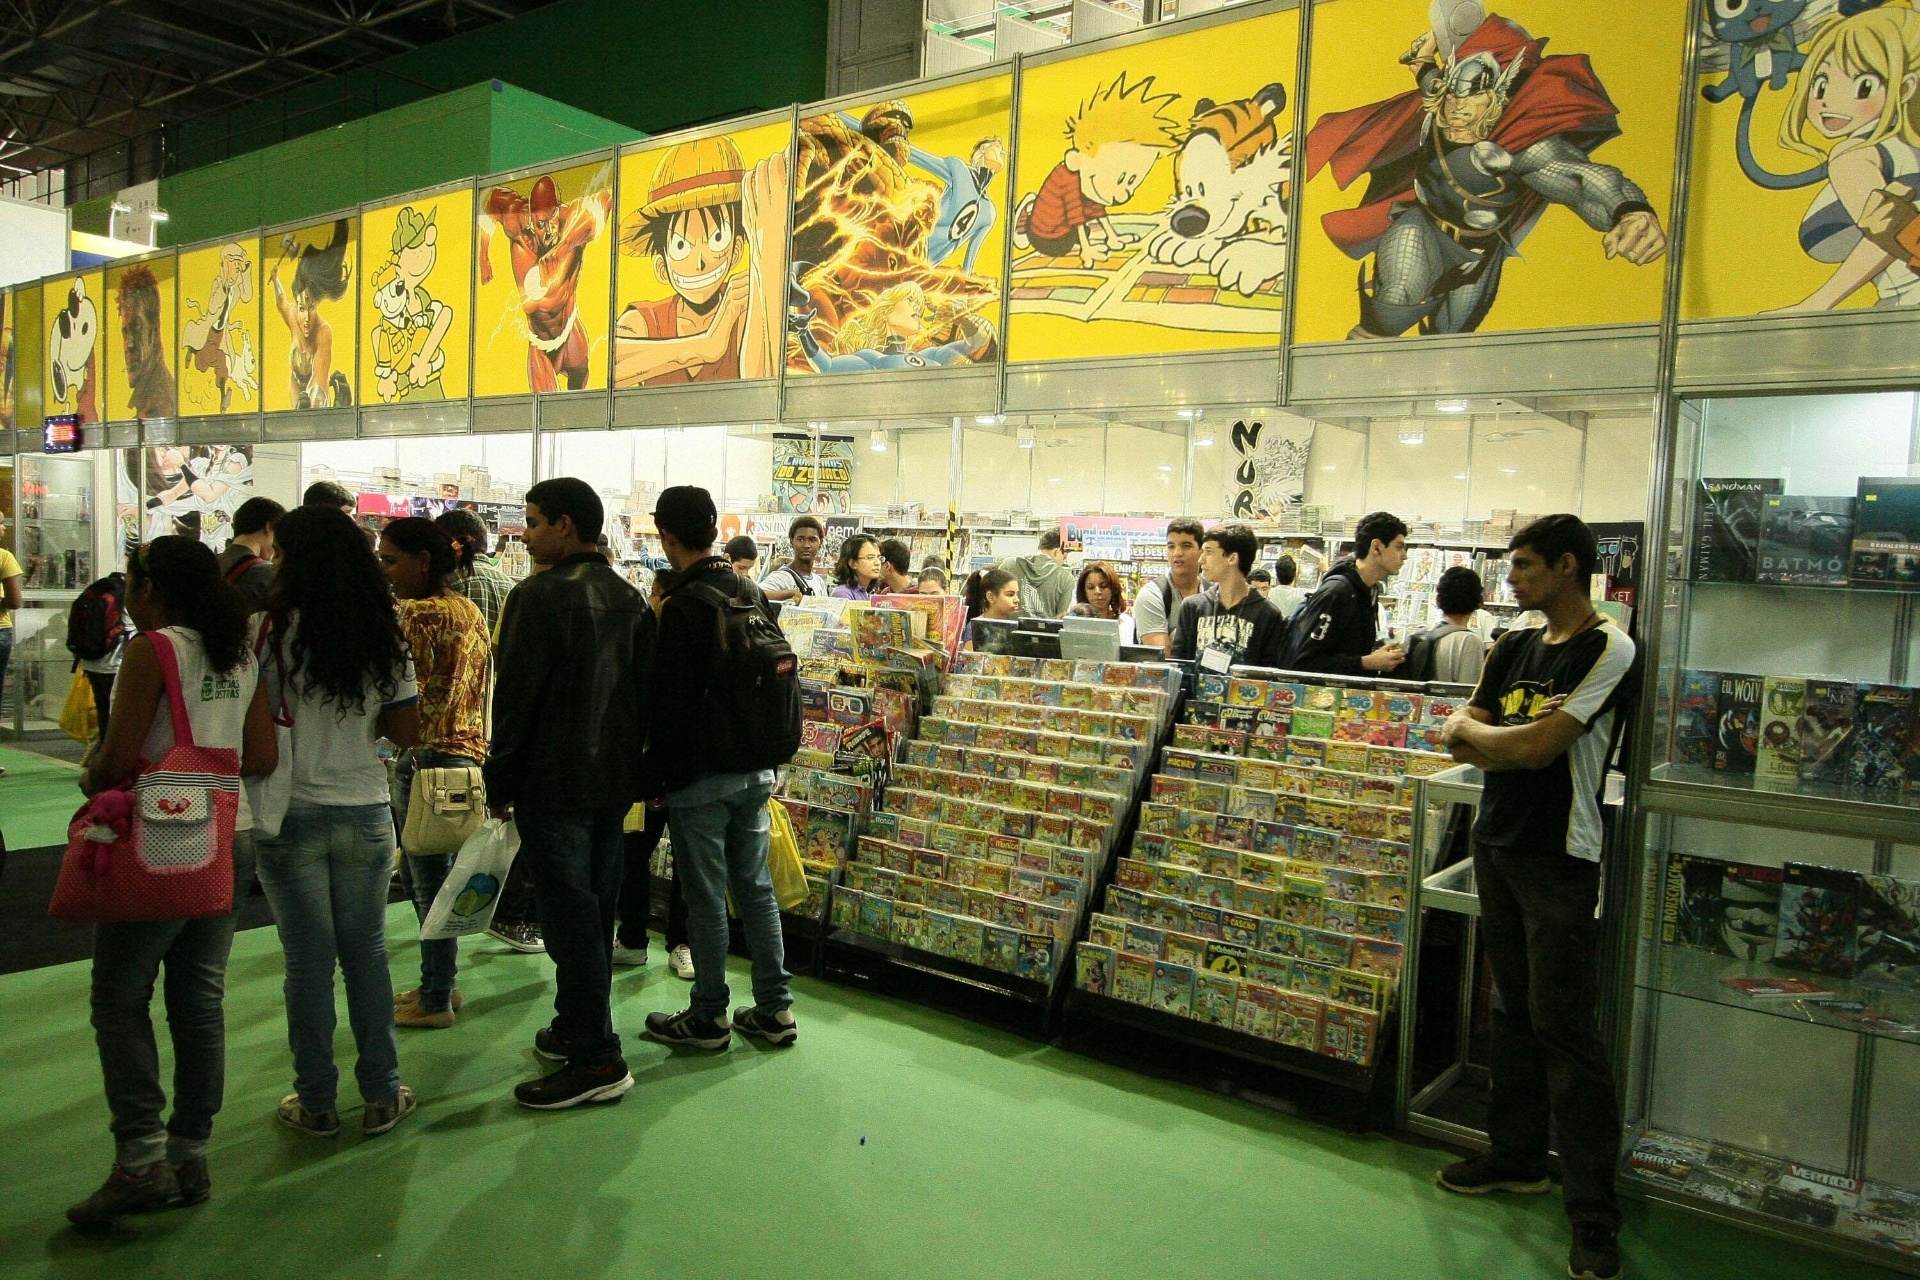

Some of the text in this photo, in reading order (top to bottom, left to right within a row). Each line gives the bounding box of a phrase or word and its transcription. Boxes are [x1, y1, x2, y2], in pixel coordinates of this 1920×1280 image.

[778, 465, 795, 478] DO
[1708, 482, 1762, 491] SANDMAN
[1310, 612, 1332, 642] 3
[1371, 755, 1406, 767] PLUTO
[1632, 1150, 1677, 1167] VERTIGO
[1790, 1165, 1856, 1190] VERTIGO
